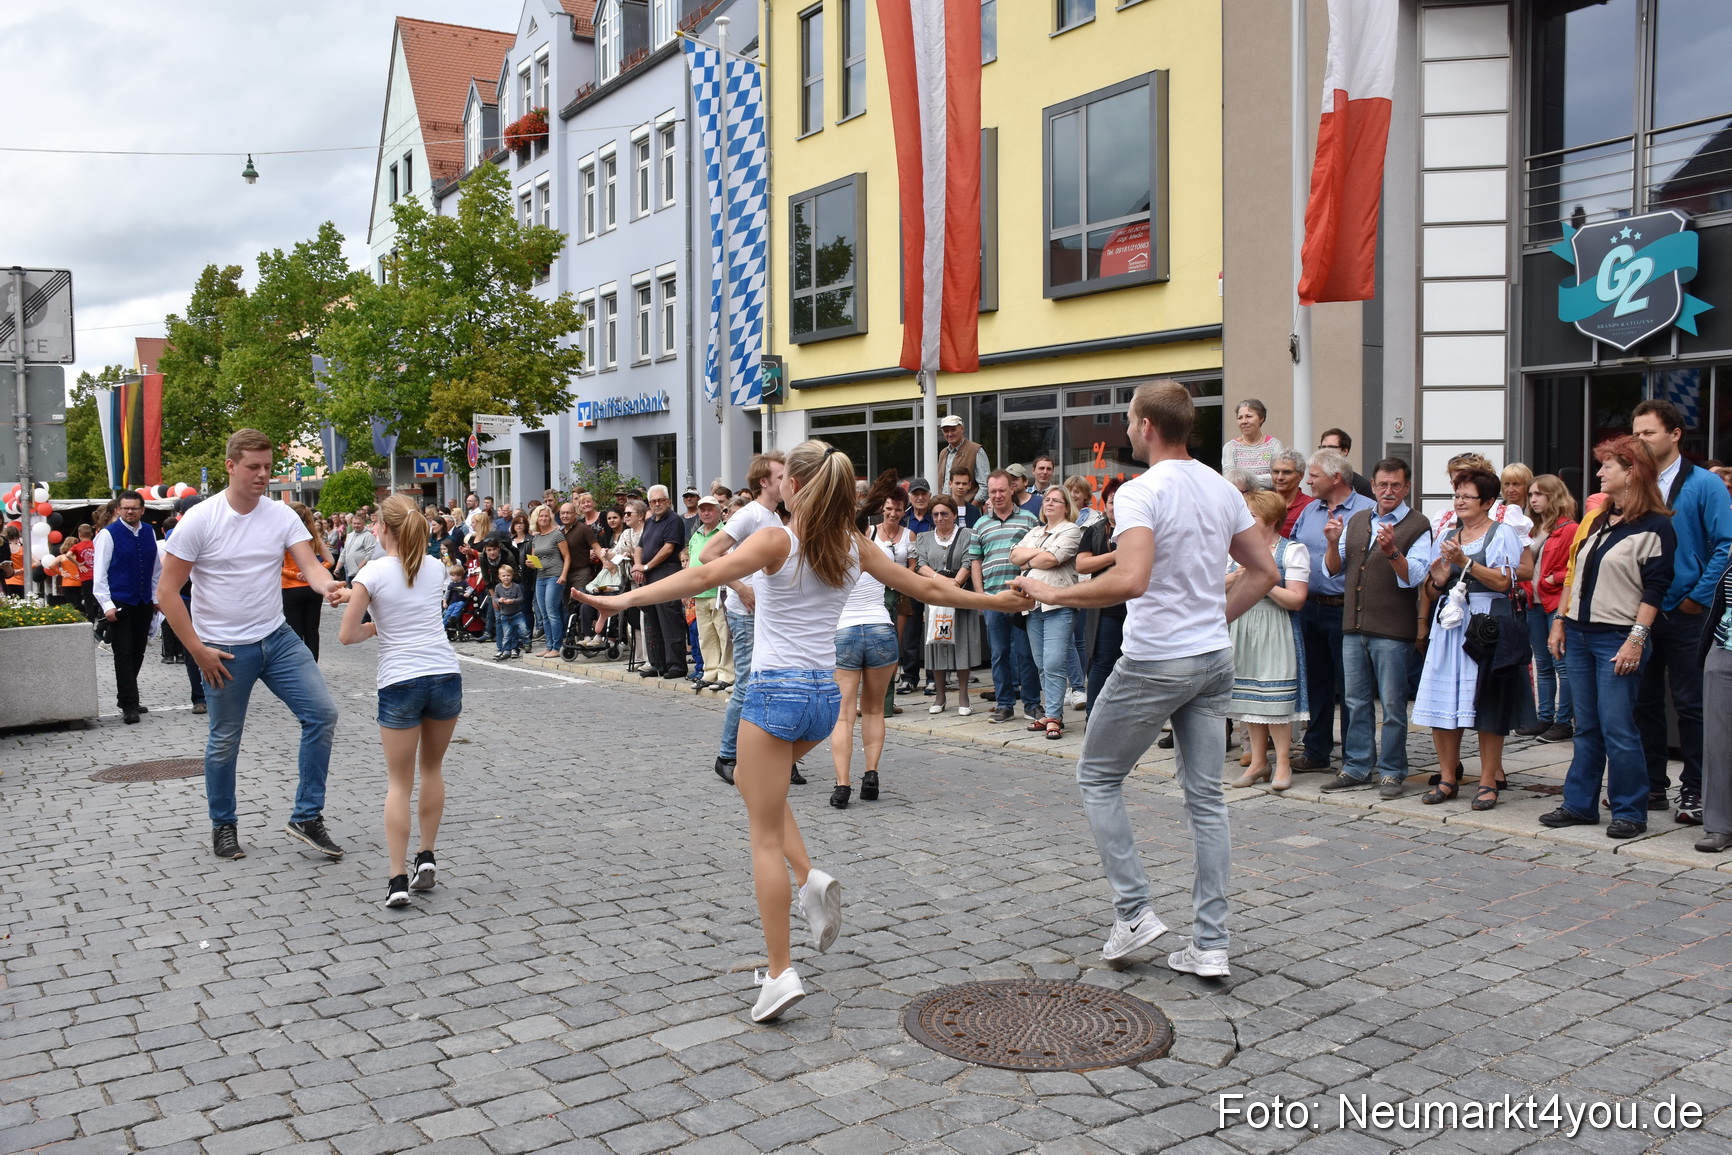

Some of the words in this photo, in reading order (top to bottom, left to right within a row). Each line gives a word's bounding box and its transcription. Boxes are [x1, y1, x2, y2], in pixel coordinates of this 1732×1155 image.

[1596, 244, 1655, 318] G2
[593, 389, 669, 418] Raiffeisenbank
[939, 625, 949, 634] M
